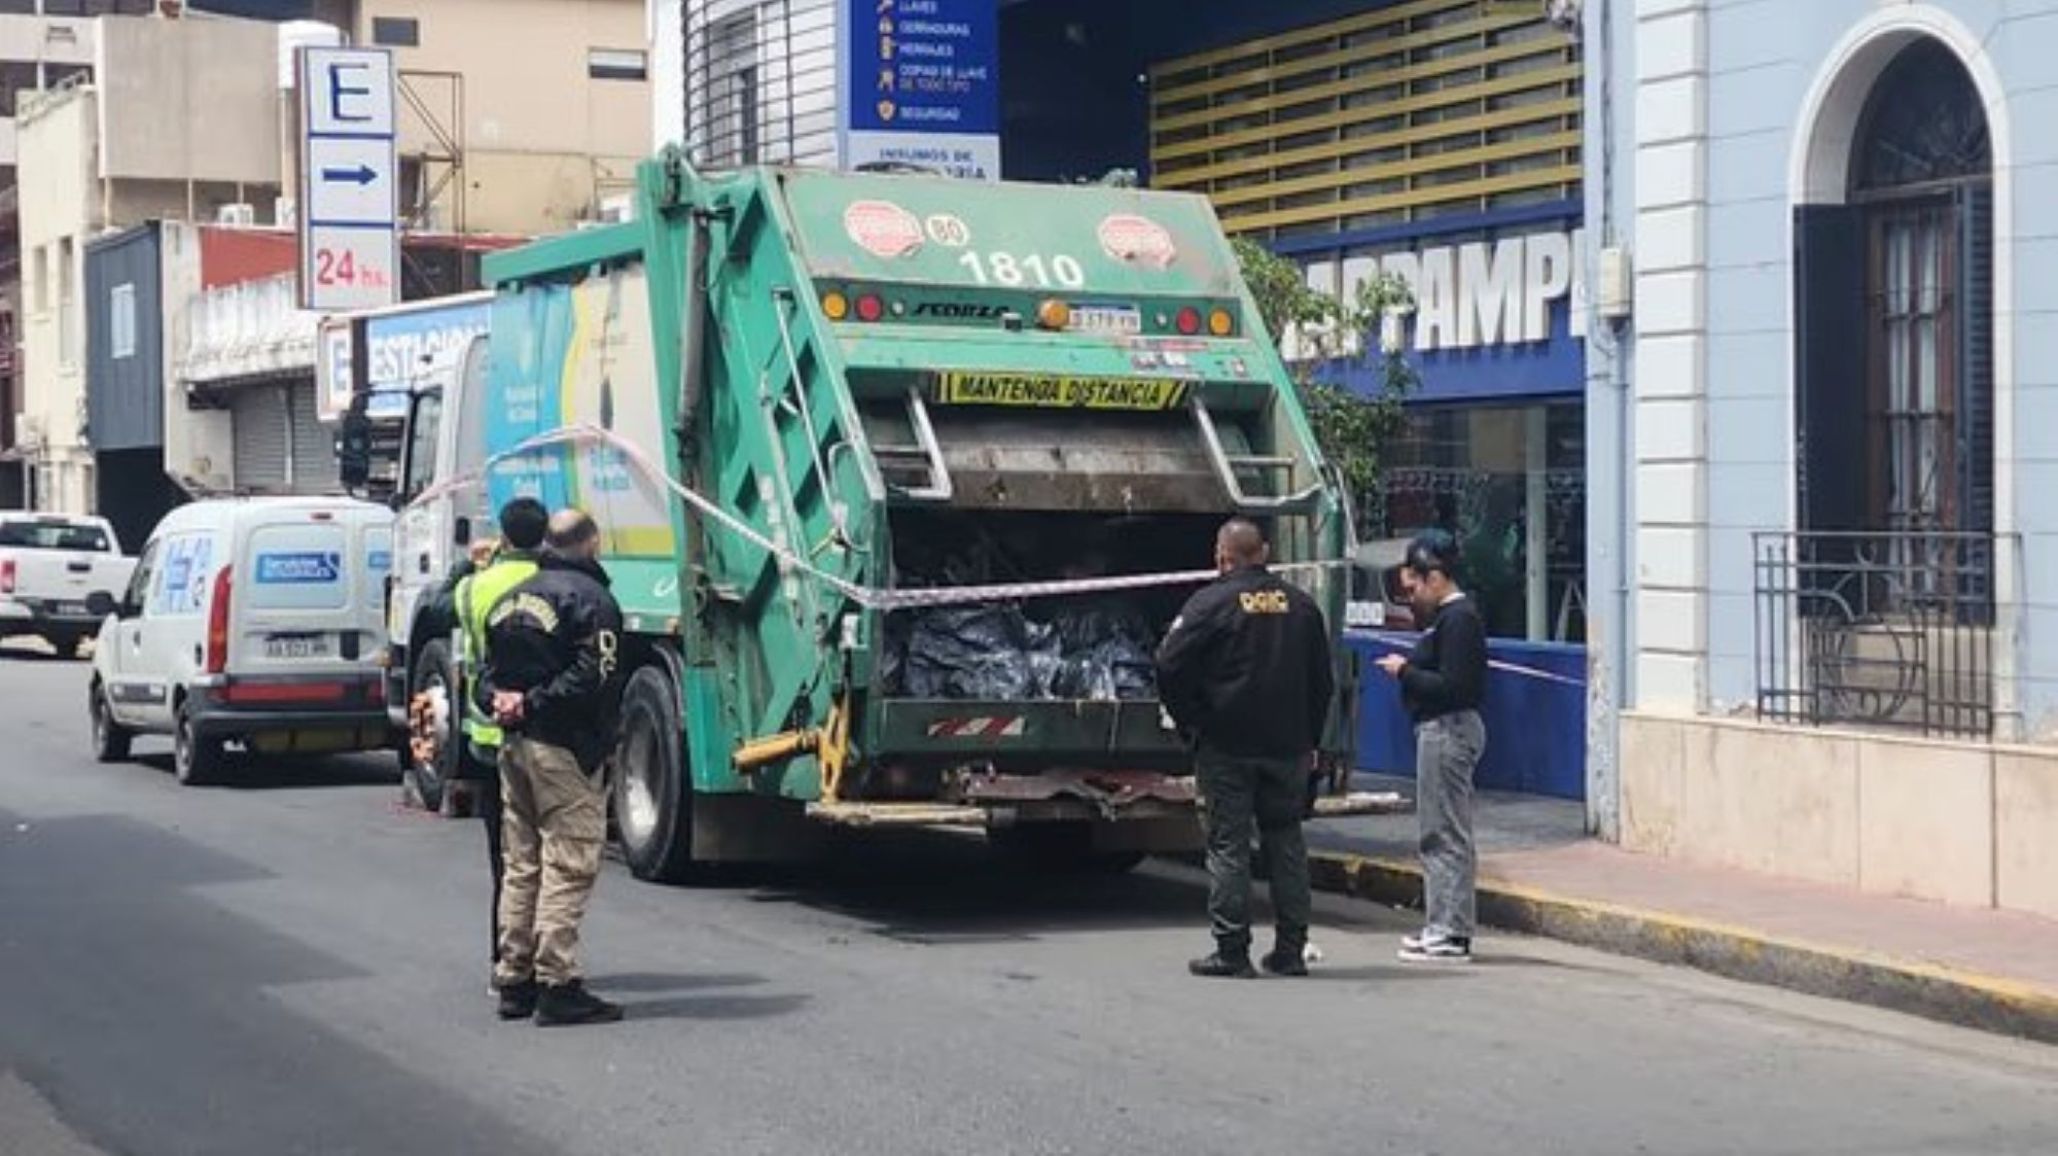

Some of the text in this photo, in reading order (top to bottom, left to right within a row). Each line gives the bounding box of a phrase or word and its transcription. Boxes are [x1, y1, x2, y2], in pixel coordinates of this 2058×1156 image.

[329, 62, 373, 121] E
[316, 248, 355, 286] 24
[959, 250, 1084, 289] 1810
[958, 373, 1162, 405] MANTENGA DISTANCIA
